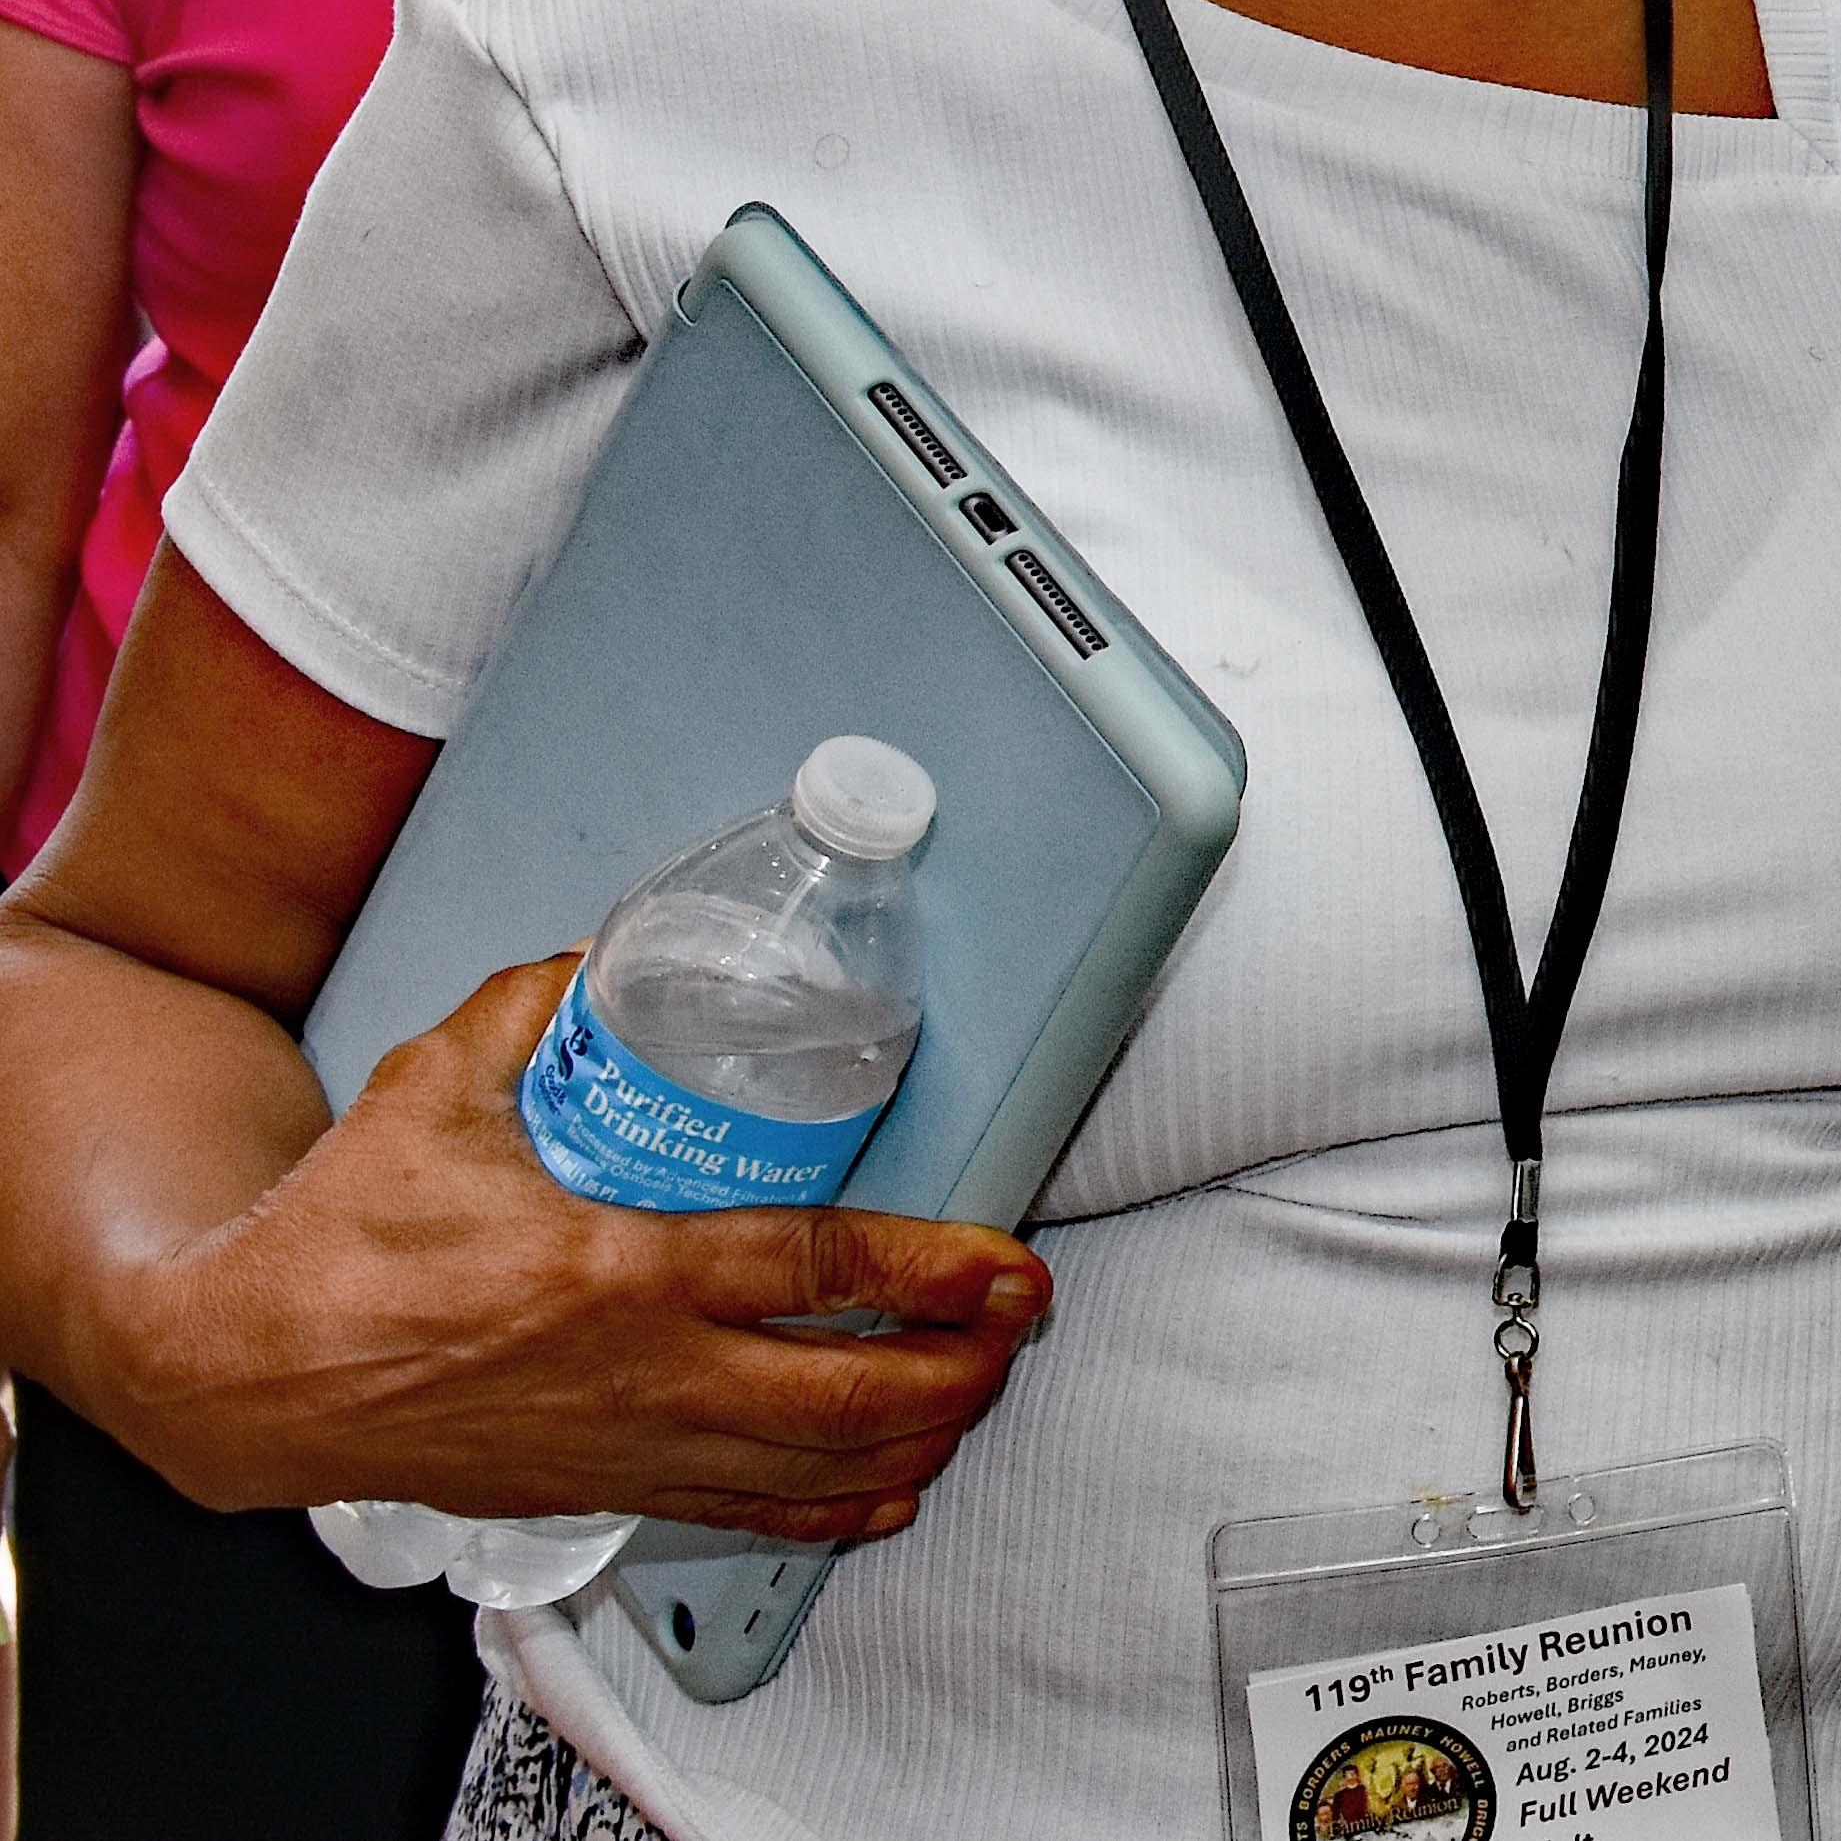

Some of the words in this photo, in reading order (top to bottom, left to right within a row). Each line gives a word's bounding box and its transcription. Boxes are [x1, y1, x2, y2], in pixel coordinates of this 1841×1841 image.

[598, 1058, 731, 1144] Purified
[583, 1083, 731, 1176] Drinking
[735, 1156, 828, 1185] Water
[599, 1186, 619, 1201] PT
[633, 1159, 653, 1175] by
[1304, 1663, 1395, 1713] 119th
[1406, 1641, 1529, 1691] Family
[1539, 1607, 1693, 1661] Reunion
[1461, 1680, 1542, 1712] Roberts,
[1546, 1665, 1624, 1695] Borders,
[1630, 1648, 1707, 1679] Mauney,
[1490, 1704, 1561, 1732] Howell,
[1567, 1689, 1625, 1718] Briggs
[1505, 1730, 1542, 1752] and
[1546, 1716, 1619, 1745] Related
[1623, 1697, 1702, 1729] Families
[1299, 1741, 1351, 1811] BORDERS
[1360, 1724, 1435, 1744] MAUNEY
[1439, 1735, 1485, 1789] HOWELL
[1515, 1756, 1577, 1786] Aug.
[1584, 1740, 1637, 1771] 2-4,
[1644, 1722, 1709, 1757] 2024
[1520, 1791, 1578, 1828] Full
[1586, 1756, 1731, 1811] Weekend
